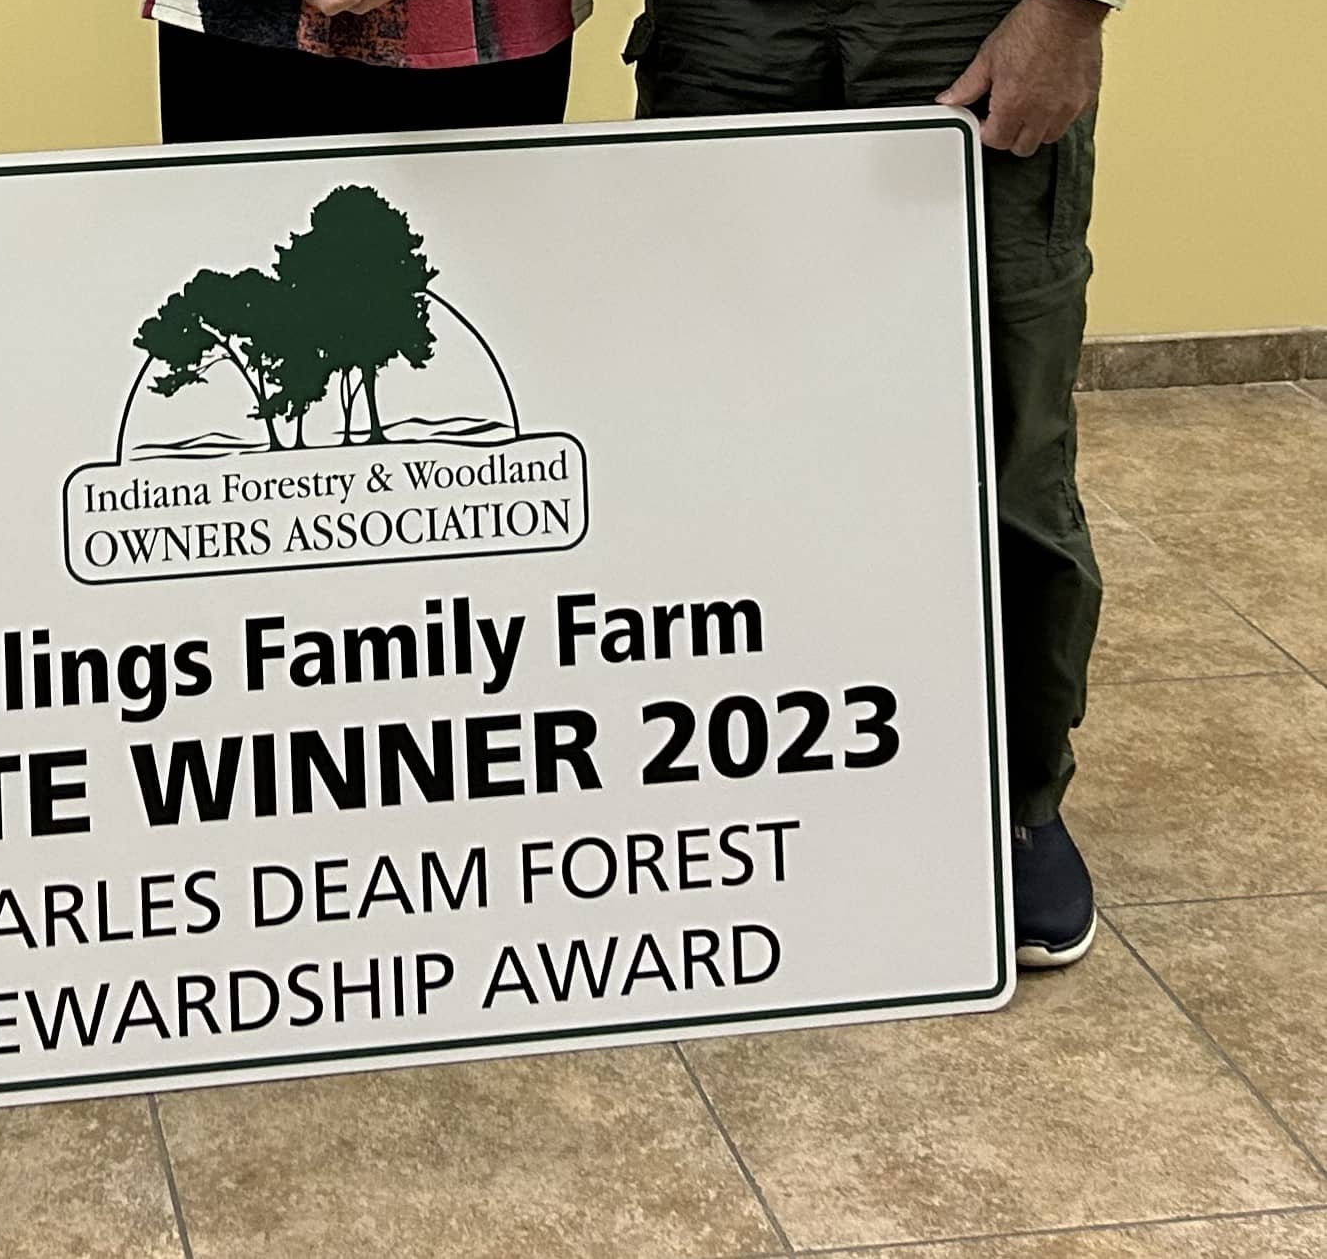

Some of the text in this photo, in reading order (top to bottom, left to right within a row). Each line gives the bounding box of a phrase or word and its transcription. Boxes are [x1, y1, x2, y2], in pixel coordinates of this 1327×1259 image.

[85, 449, 569, 514] Indiana Forestry & Woodland
[84, 498, 571, 567] OWNERS ASSOCIATION
[245, 596, 526, 695] Family
[557, 593, 763, 667] Farm
[129, 709, 603, 827] WINNER
[642, 685, 900, 785] 2023
[253, 847, 488, 928] DEAM
[521, 820, 800, 904] FOREST
[481, 924, 781, 1009] AWARD
